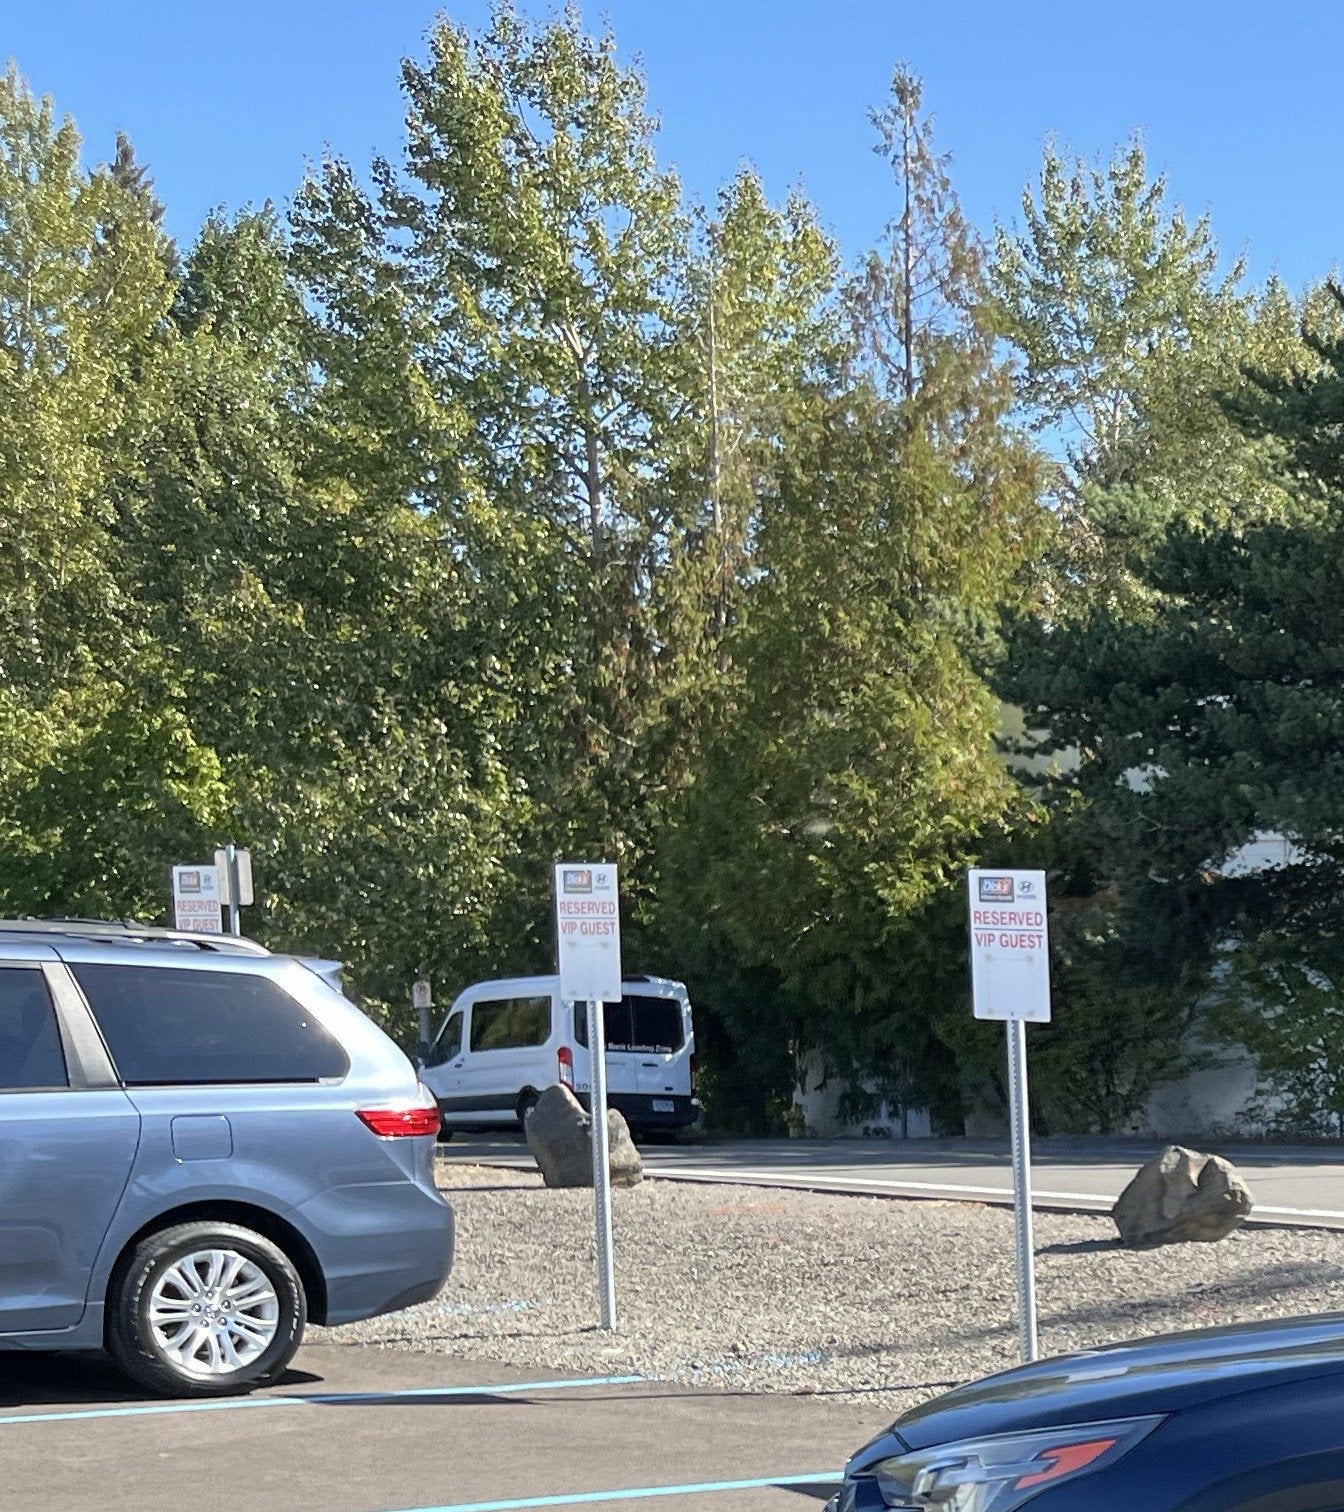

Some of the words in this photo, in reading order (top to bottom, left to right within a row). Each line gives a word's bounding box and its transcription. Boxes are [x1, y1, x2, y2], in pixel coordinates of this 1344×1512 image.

[559, 901, 616, 915] RESERVED
[973, 911, 1043, 927] RESERVED
[560, 922, 578, 935] VIP
[580, 922, 616, 936] GUEST
[975, 933, 996, 948] VIP
[1000, 933, 1044, 949] GUEST
